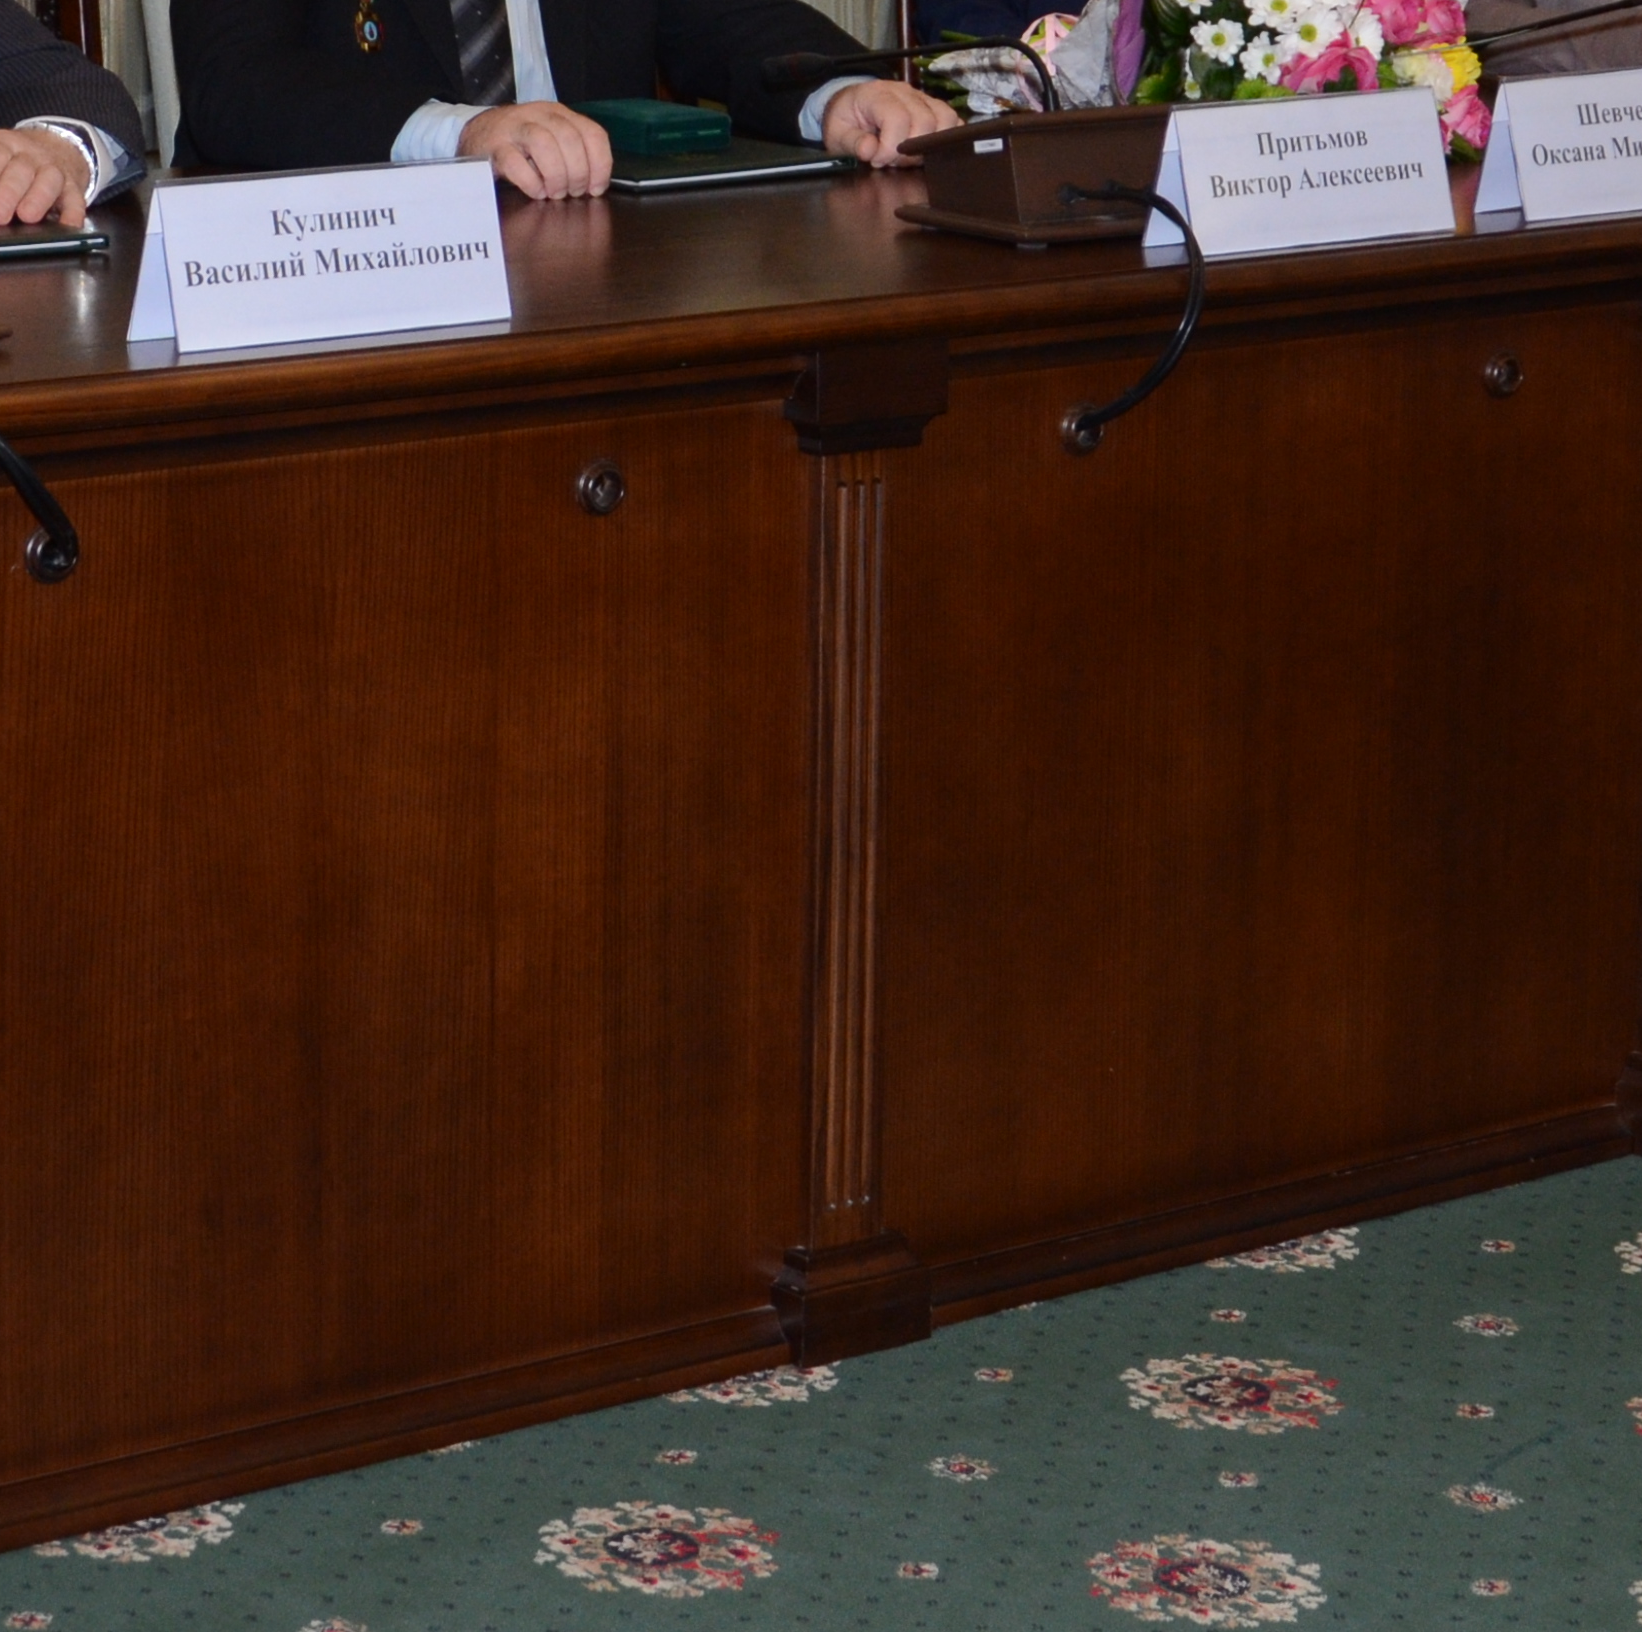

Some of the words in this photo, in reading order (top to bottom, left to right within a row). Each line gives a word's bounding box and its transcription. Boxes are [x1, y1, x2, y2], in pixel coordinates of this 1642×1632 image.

[1257, 129, 1369, 160] Притьмов
[1531, 144, 1607, 166] Оксана
[1210, 172, 1292, 198] Виктор
[1299, 161, 1424, 190] Алексеевич
[271, 206, 397, 241] Кулинич
[184, 253, 306, 287] Василий
[315, 240, 491, 276] Михайлович
